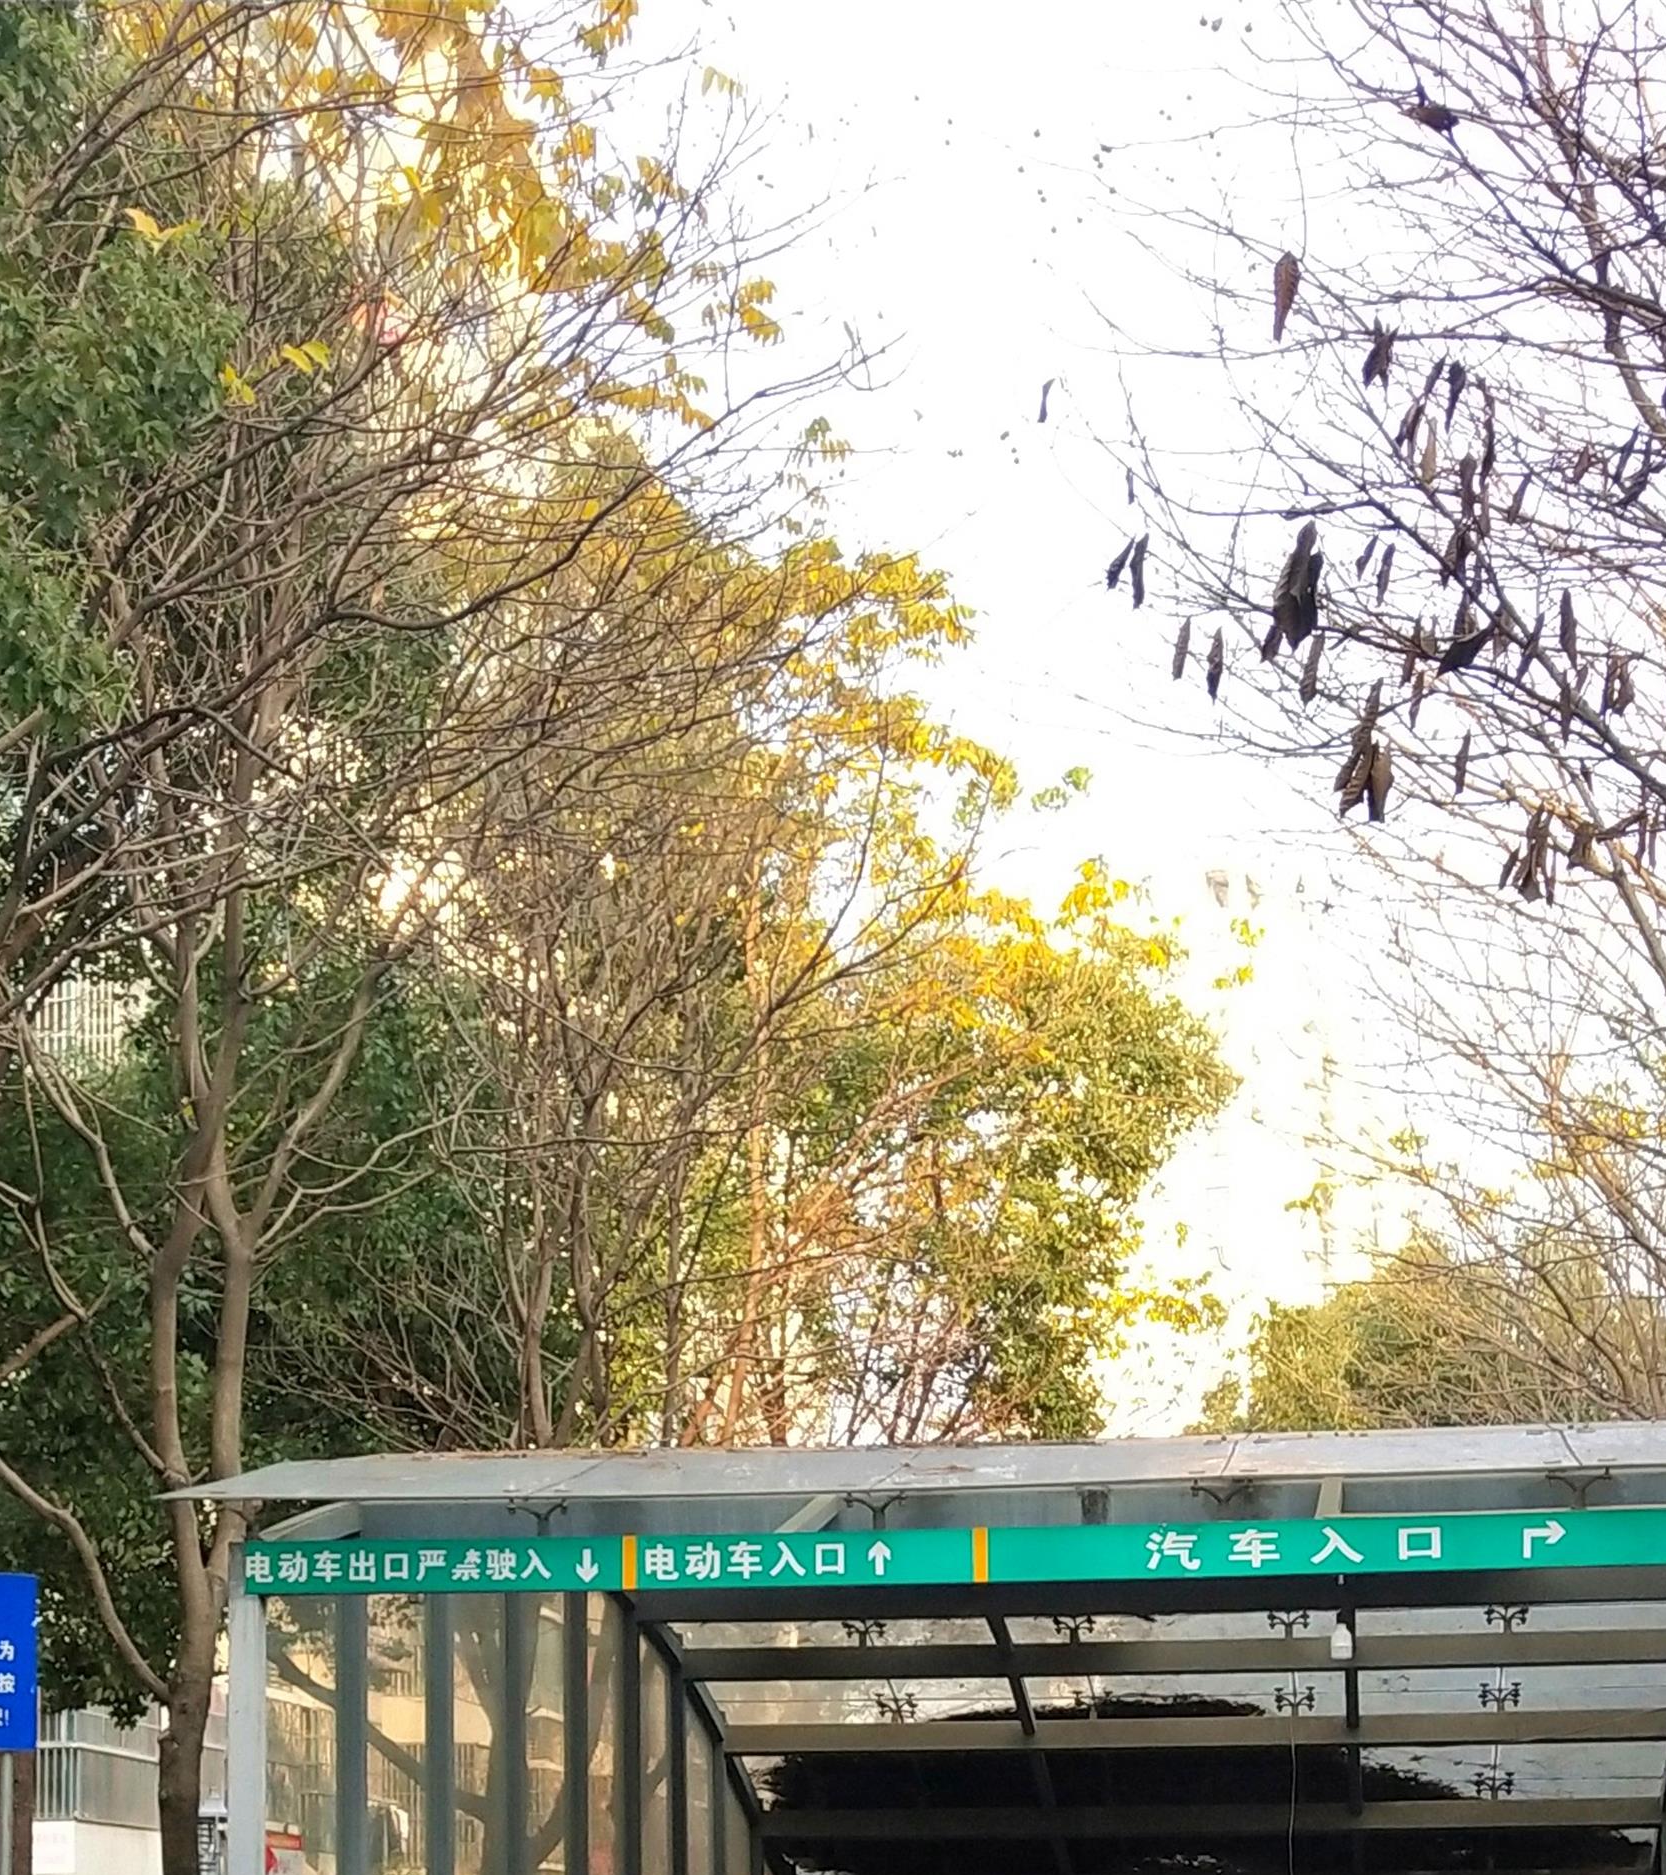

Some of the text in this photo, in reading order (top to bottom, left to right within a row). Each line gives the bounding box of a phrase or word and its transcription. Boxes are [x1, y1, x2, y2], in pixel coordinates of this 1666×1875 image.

[245, 1548, 552, 1583] 电动车出口严禁驶入
[644, 1541, 846, 1581] 电动车入口
[1145, 1526, 1442, 1571] 汽车入口
